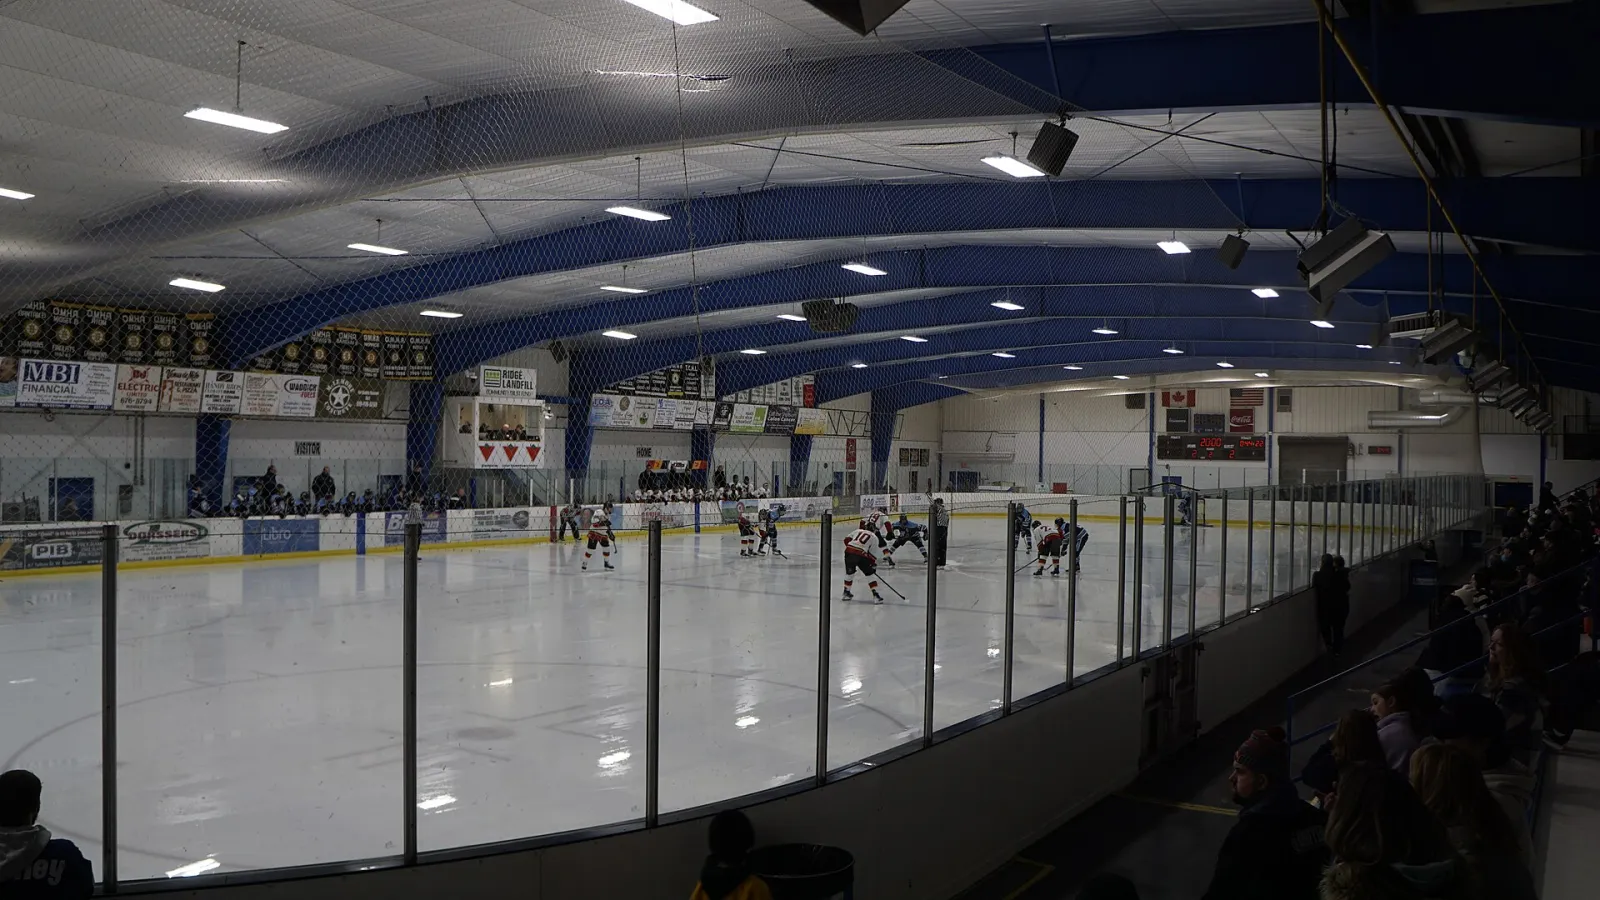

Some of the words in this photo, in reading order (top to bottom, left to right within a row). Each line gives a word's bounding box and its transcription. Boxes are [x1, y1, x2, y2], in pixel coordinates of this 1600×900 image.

[52, 307, 79, 318] OMHA
[86, 309, 113, 320] OMHA
[121, 314, 146, 324] OMHA
[26, 362, 79, 384] MBI
[502, 370, 523, 380] RIDGE
[22, 383, 77, 395] FINANCIAL
[118, 382, 159, 392] ELECTRIC
[289, 382, 318, 391] WADDICK
[502, 380, 534, 391] LANDFILL
[295, 441, 321, 455] VISITOR
[636, 447, 652, 457] HOME
[1229, 450, 1235, 459] 2
[855, 532, 870, 544] 10
[37, 545, 68, 557] PIB
